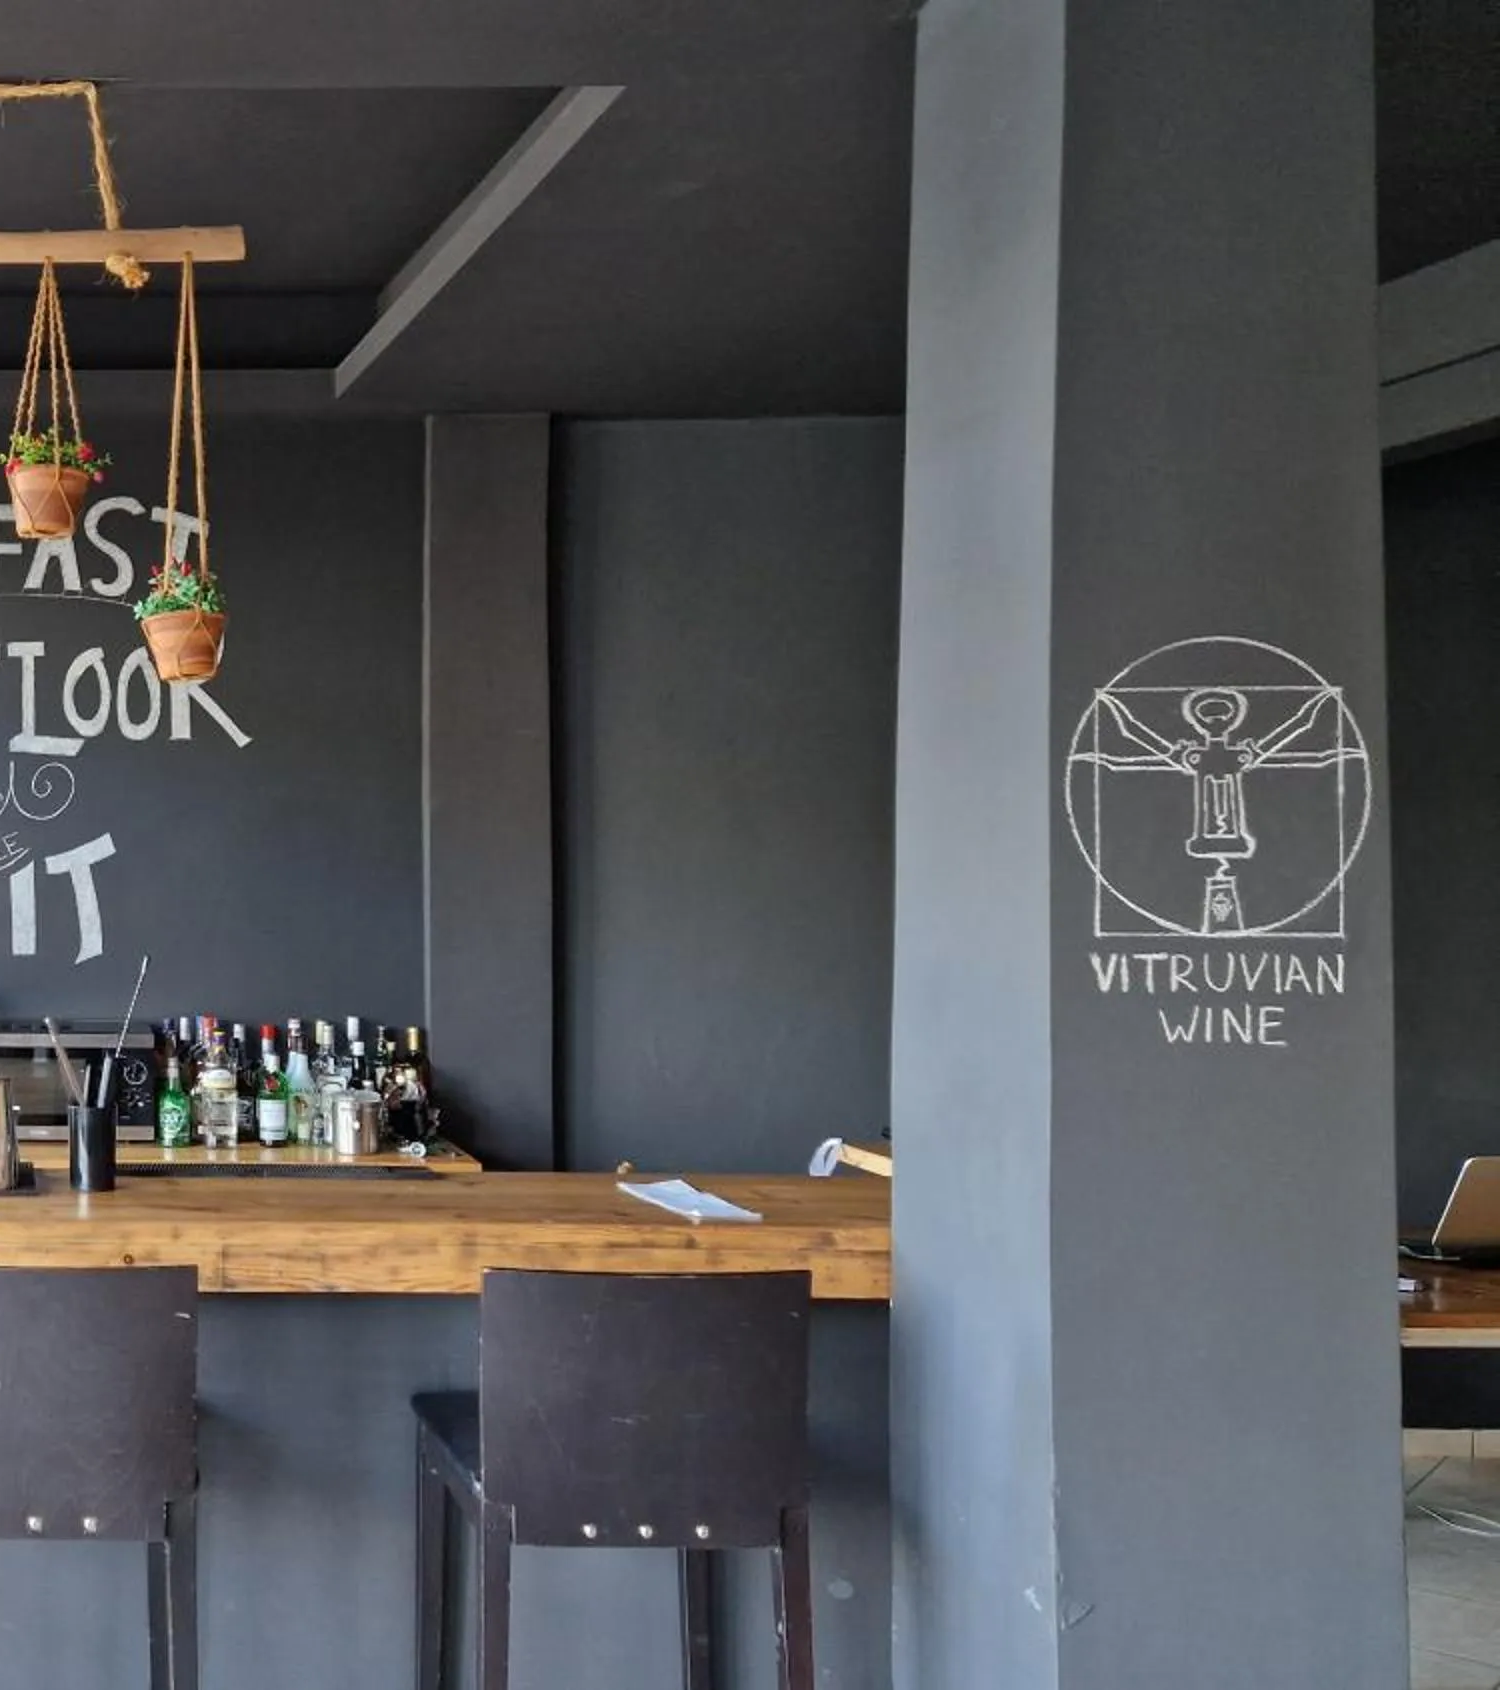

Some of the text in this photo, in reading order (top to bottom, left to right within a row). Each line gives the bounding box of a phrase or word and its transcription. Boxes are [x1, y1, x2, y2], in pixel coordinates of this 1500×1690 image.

[9, 833, 117, 965] IT
[1088, 951, 1345, 994] VITRUVIAN
[1159, 1004, 1289, 1046] WINE
